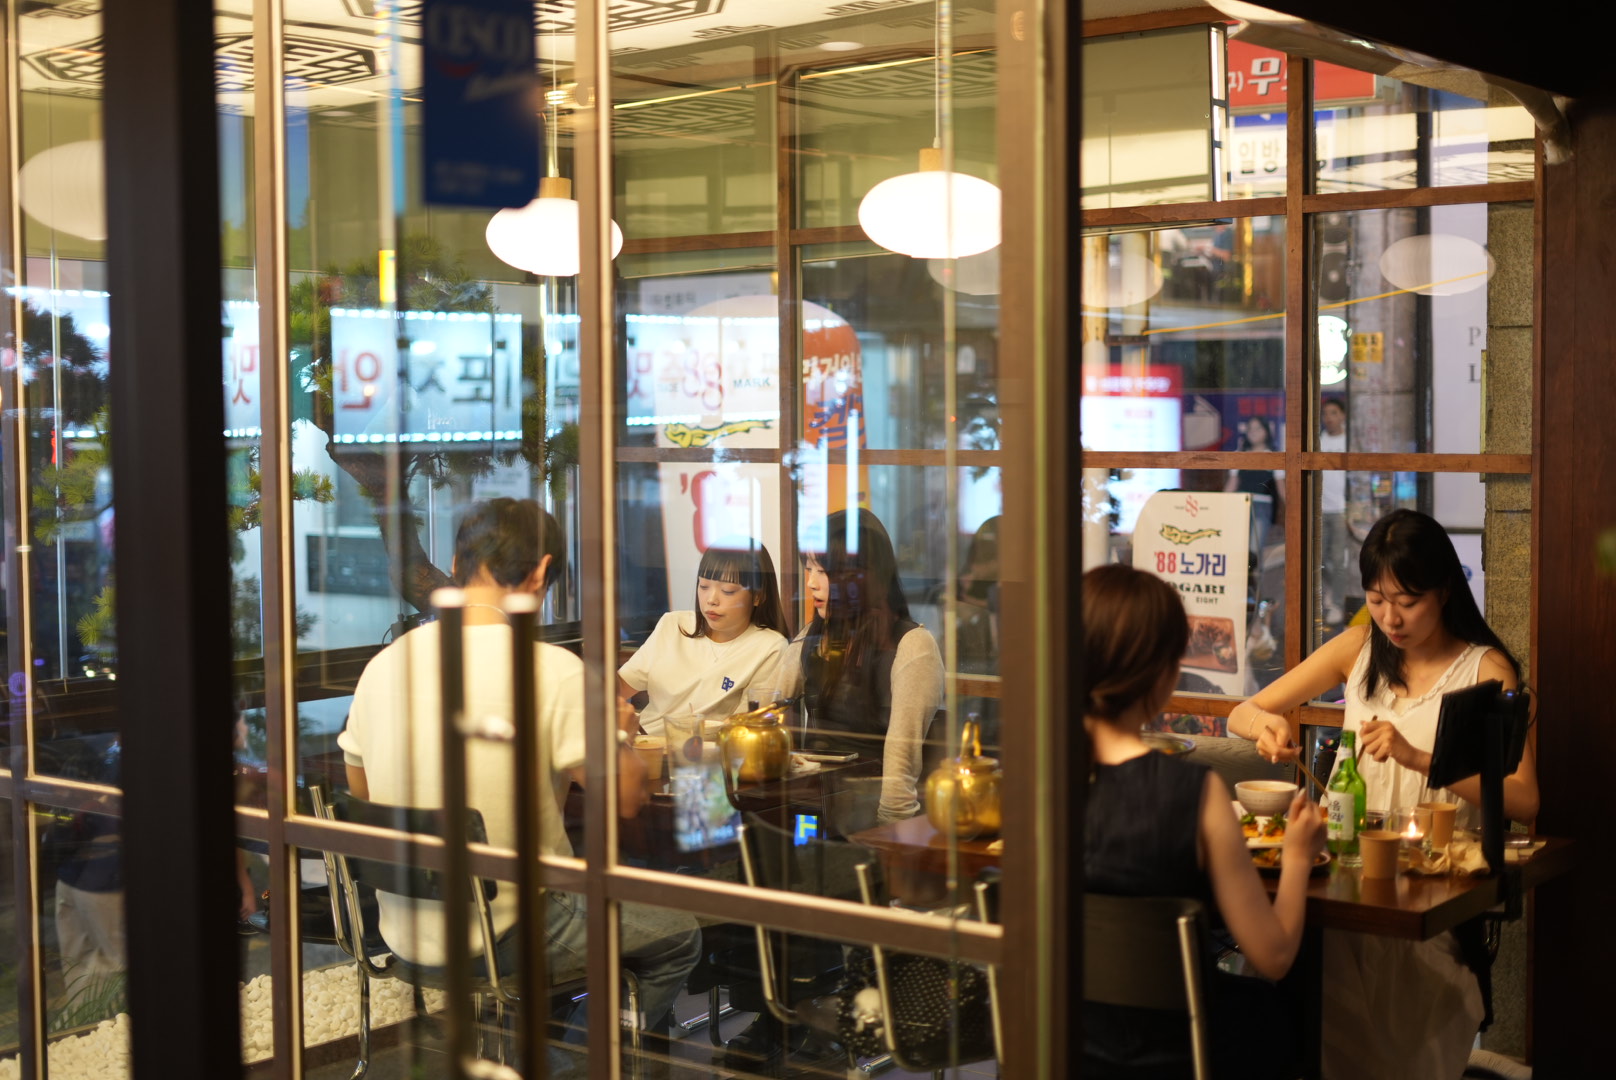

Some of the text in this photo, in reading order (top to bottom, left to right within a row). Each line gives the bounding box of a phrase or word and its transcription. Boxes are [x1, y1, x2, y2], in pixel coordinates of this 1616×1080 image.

[1247, 57, 1287, 95] 무
[733, 377, 771, 389] MARK
[1180, 552, 1226, 577] 노가리
[1196, 596, 1218, 605] EIGHT
